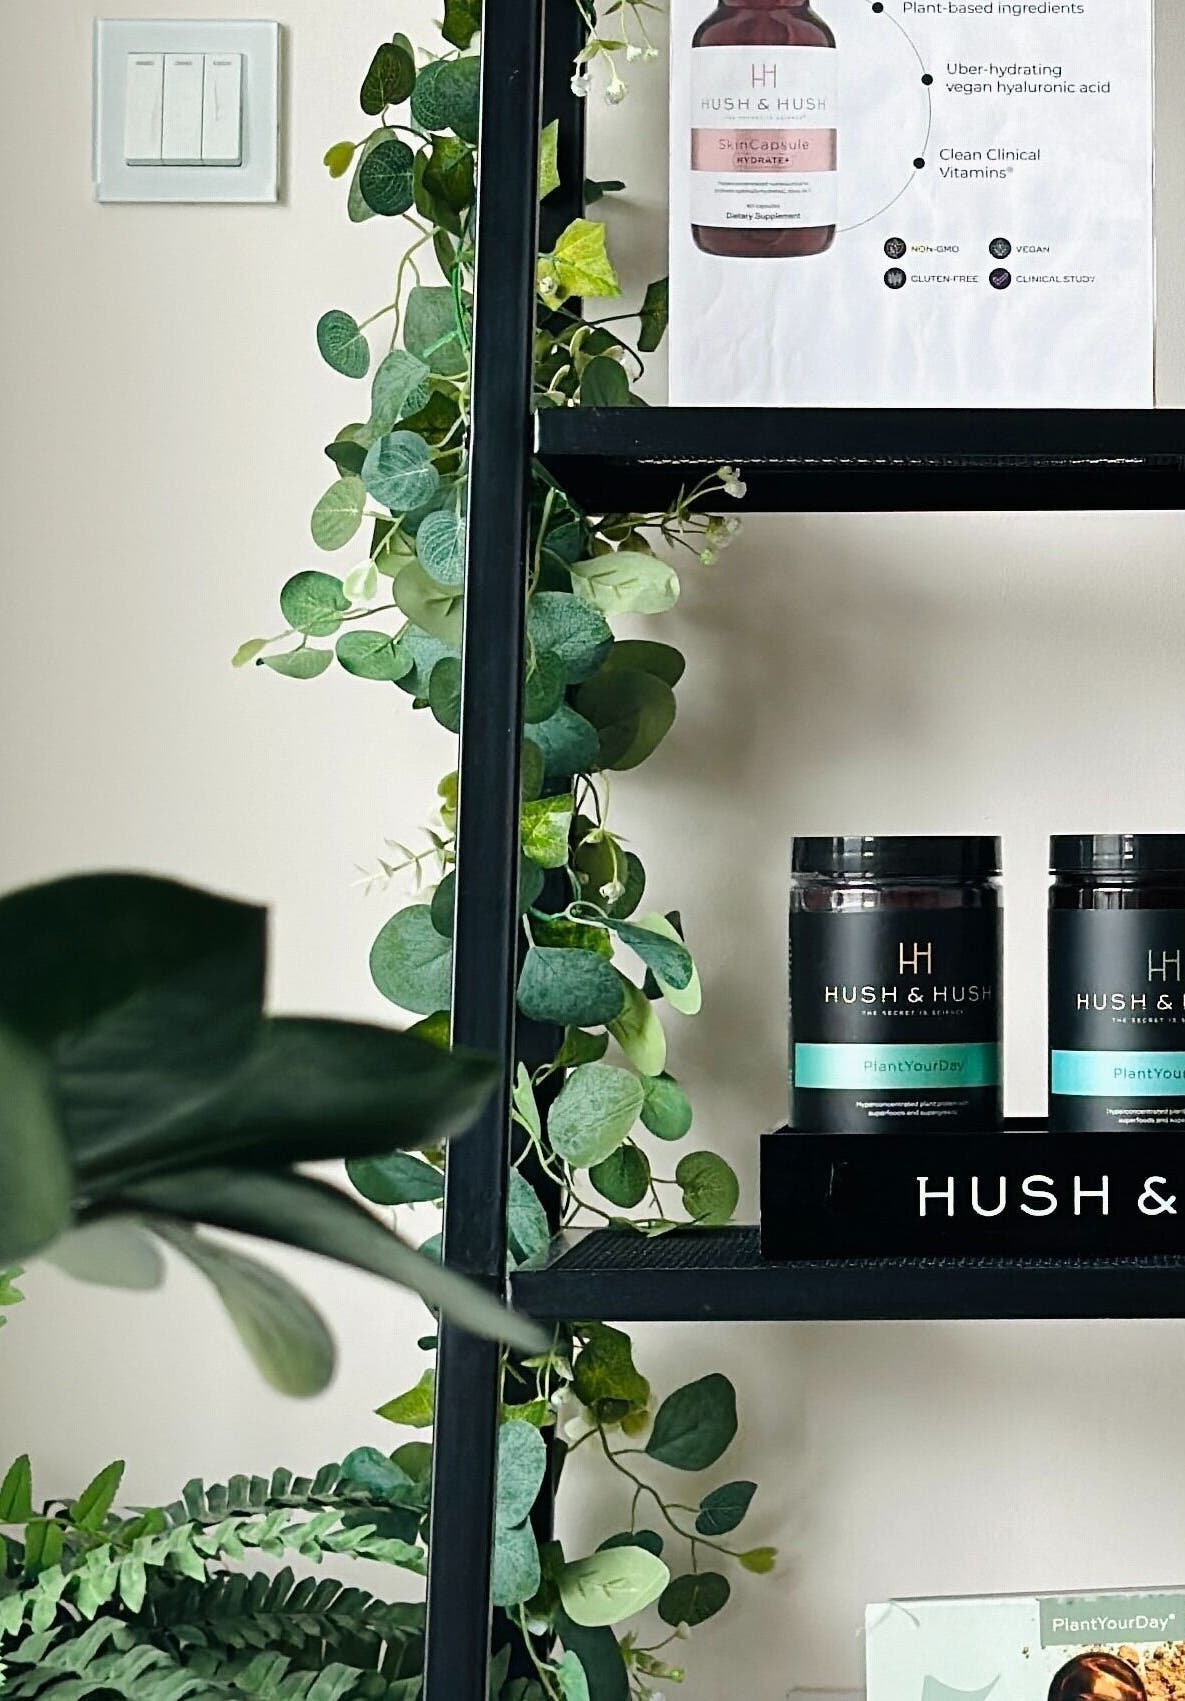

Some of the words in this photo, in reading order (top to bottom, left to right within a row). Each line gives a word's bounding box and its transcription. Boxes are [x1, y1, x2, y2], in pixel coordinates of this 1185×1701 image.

[902, 1, 993, 14] Plant-based
[998, 1, 1085, 16] ingredients
[946, 63, 1062, 77] Uber-hydrating
[946, 83, 992, 95] vegan
[997, 81, 1075, 95] hyaluronic
[1079, 81, 1110, 93] acid
[701, 98, 749, 110] HUSH
[757, 98, 769, 110] &
[777, 98, 827, 110] HUSH
[719, 139, 810, 151] SkinCapsule
[939, 148, 982, 161] Clean
[986, 148, 1041, 161] Clinical
[726, 212, 753, 220] Dietary
[754, 212, 801, 221] Supplement
[911, 245, 960, 253] NON-GMO
[1016, 245, 1050, 253] VEGAN
[911, 275, 979, 283] GLUTEN-FREE
[1016, 275, 1063, 283] CLINICAL
[825, 985, 897, 1003] HUSH
[907, 986, 924, 1003] &
[933, 985, 992, 1003] HUSH
[1077, 993, 1146, 1011] HUSH
[1156, 994, 1173, 1010] &
[916, 1175, 1109, 1216] HUSH
[1137, 1175, 1178, 1215] &
